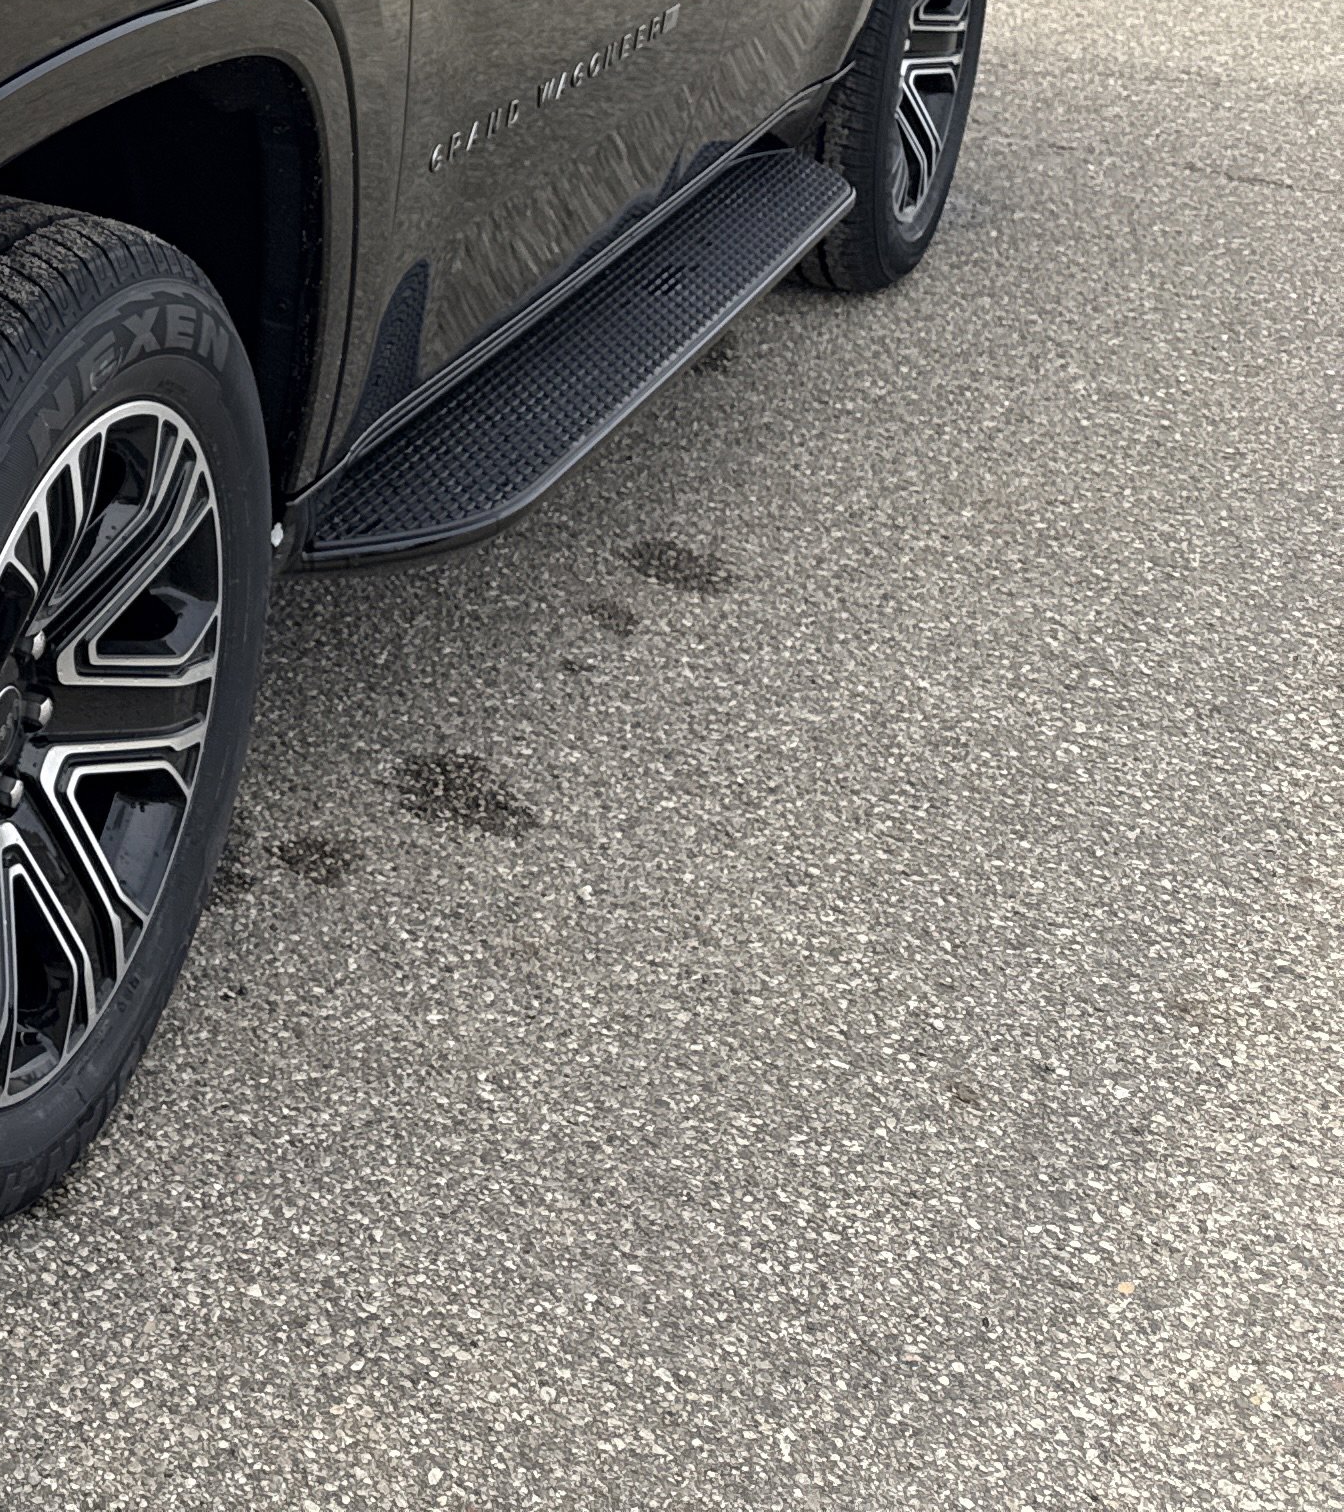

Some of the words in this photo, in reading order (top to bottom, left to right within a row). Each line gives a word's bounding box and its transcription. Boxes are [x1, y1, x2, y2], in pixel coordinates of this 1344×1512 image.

[429, 99, 520, 173] GRAND
[537, 16, 661, 108] WAGONEER
[28, 303, 230, 467] NEXEN
